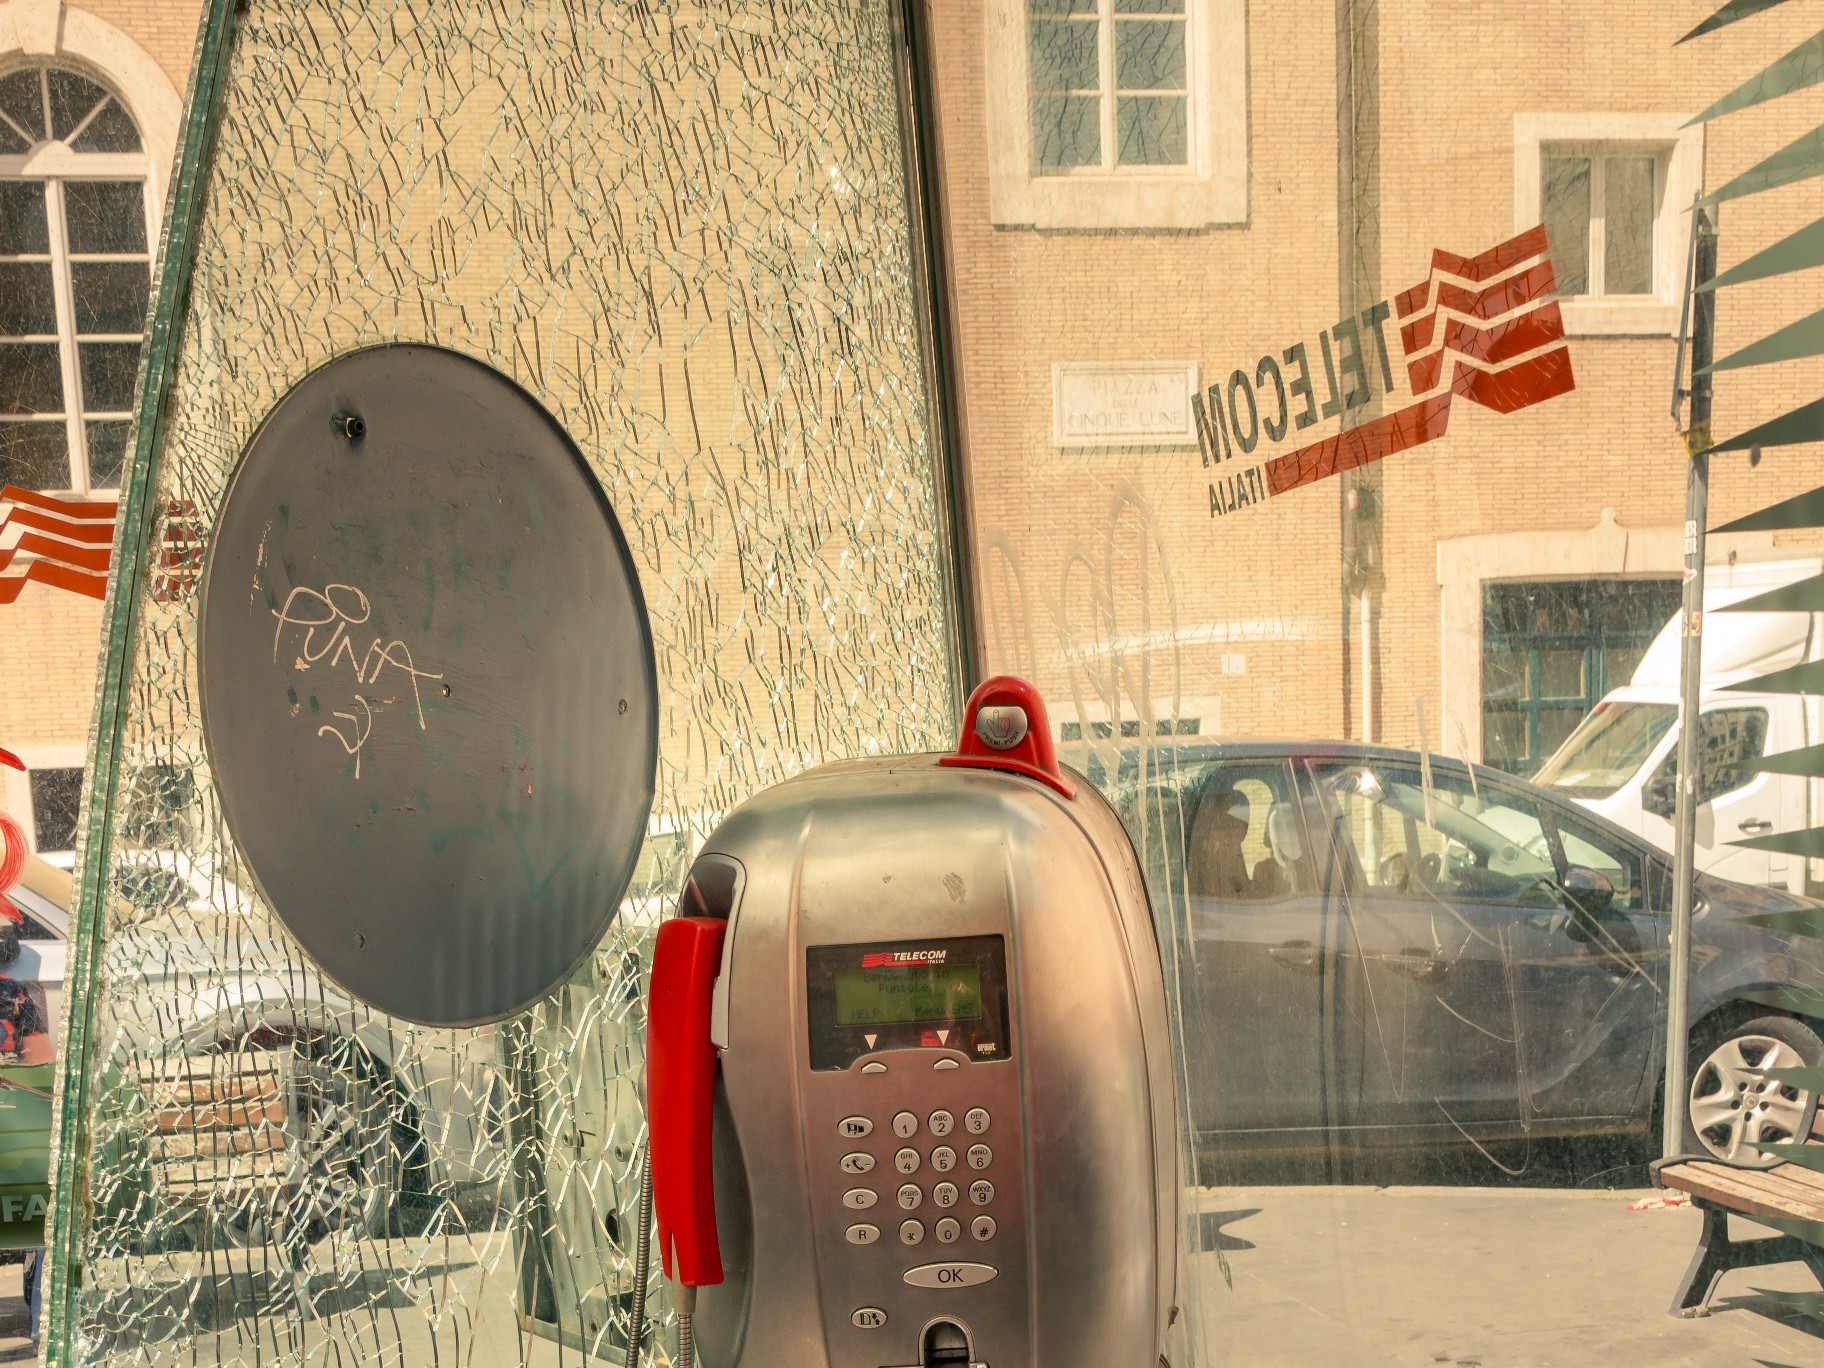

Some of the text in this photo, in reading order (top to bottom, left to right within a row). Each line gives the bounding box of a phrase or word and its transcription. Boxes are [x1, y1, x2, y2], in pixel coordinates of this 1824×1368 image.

[1092, 380, 1159, 396] PIAZZA
[1068, 410, 1185, 429] CINQUE LUNE
[893, 950, 946, 961] TELECOM
[851, 1007, 880, 1019] HELP
[902, 1124, 907, 1134] 1
[937, 1122, 946, 1133] 2
[974, 1120, 982, 1131] 3
[903, 1162, 912, 1171] 4
[940, 1159, 948, 1169] 5
[976, 1157, 984, 1167] 6
[855, 1194, 865, 1205] C
[906, 1197, 914, 1207] 7
[942, 1195, 950, 1205] 8
[979, 1192, 987, 1202] 9
[858, 1229, 867, 1240] R
[944, 1230, 952, 1239] 0
[937, 1268, 965, 1284] OK
